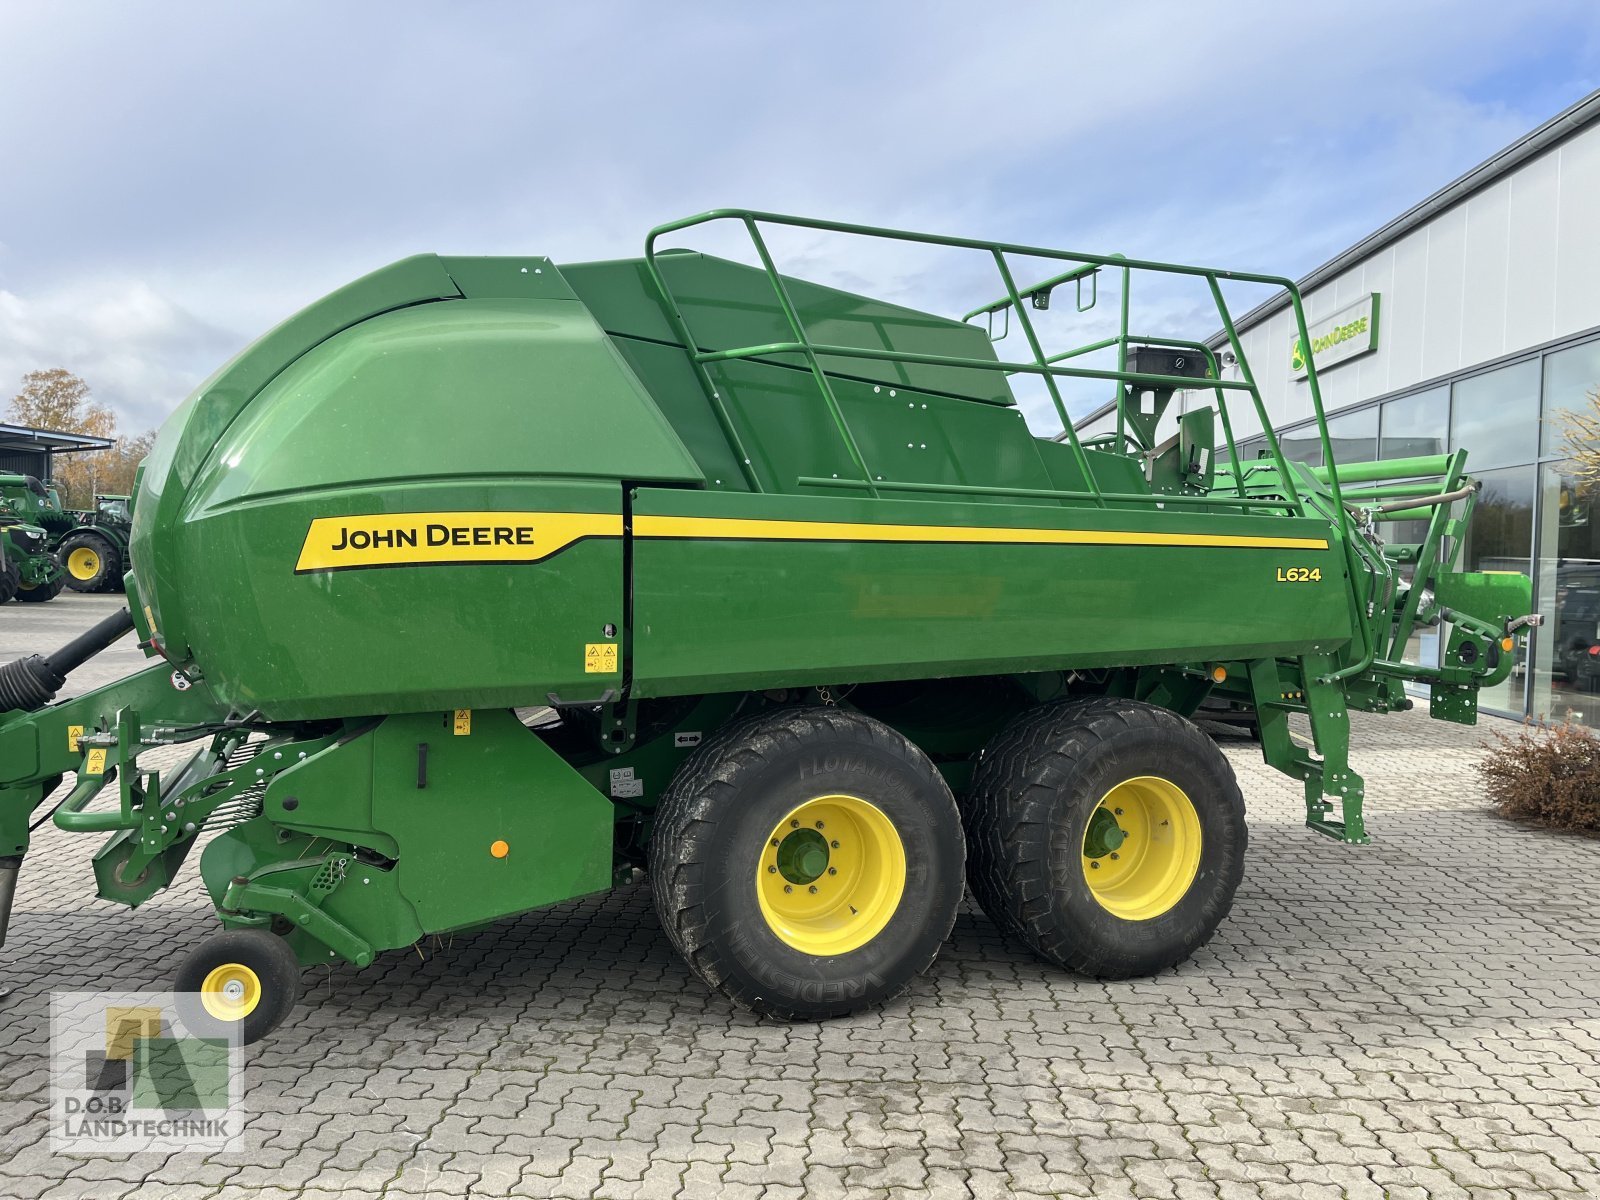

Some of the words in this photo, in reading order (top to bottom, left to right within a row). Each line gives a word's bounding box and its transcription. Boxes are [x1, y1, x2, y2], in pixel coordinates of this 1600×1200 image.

[1333, 316, 1368, 344] DEERE
[331, 527, 418, 551] JOHN
[426, 524, 535, 547] DEERE
[1276, 566, 1323, 583] L624
[799, 752, 914, 801] FLOTATION
[720, 918, 886, 1003] VREDESTEIN
